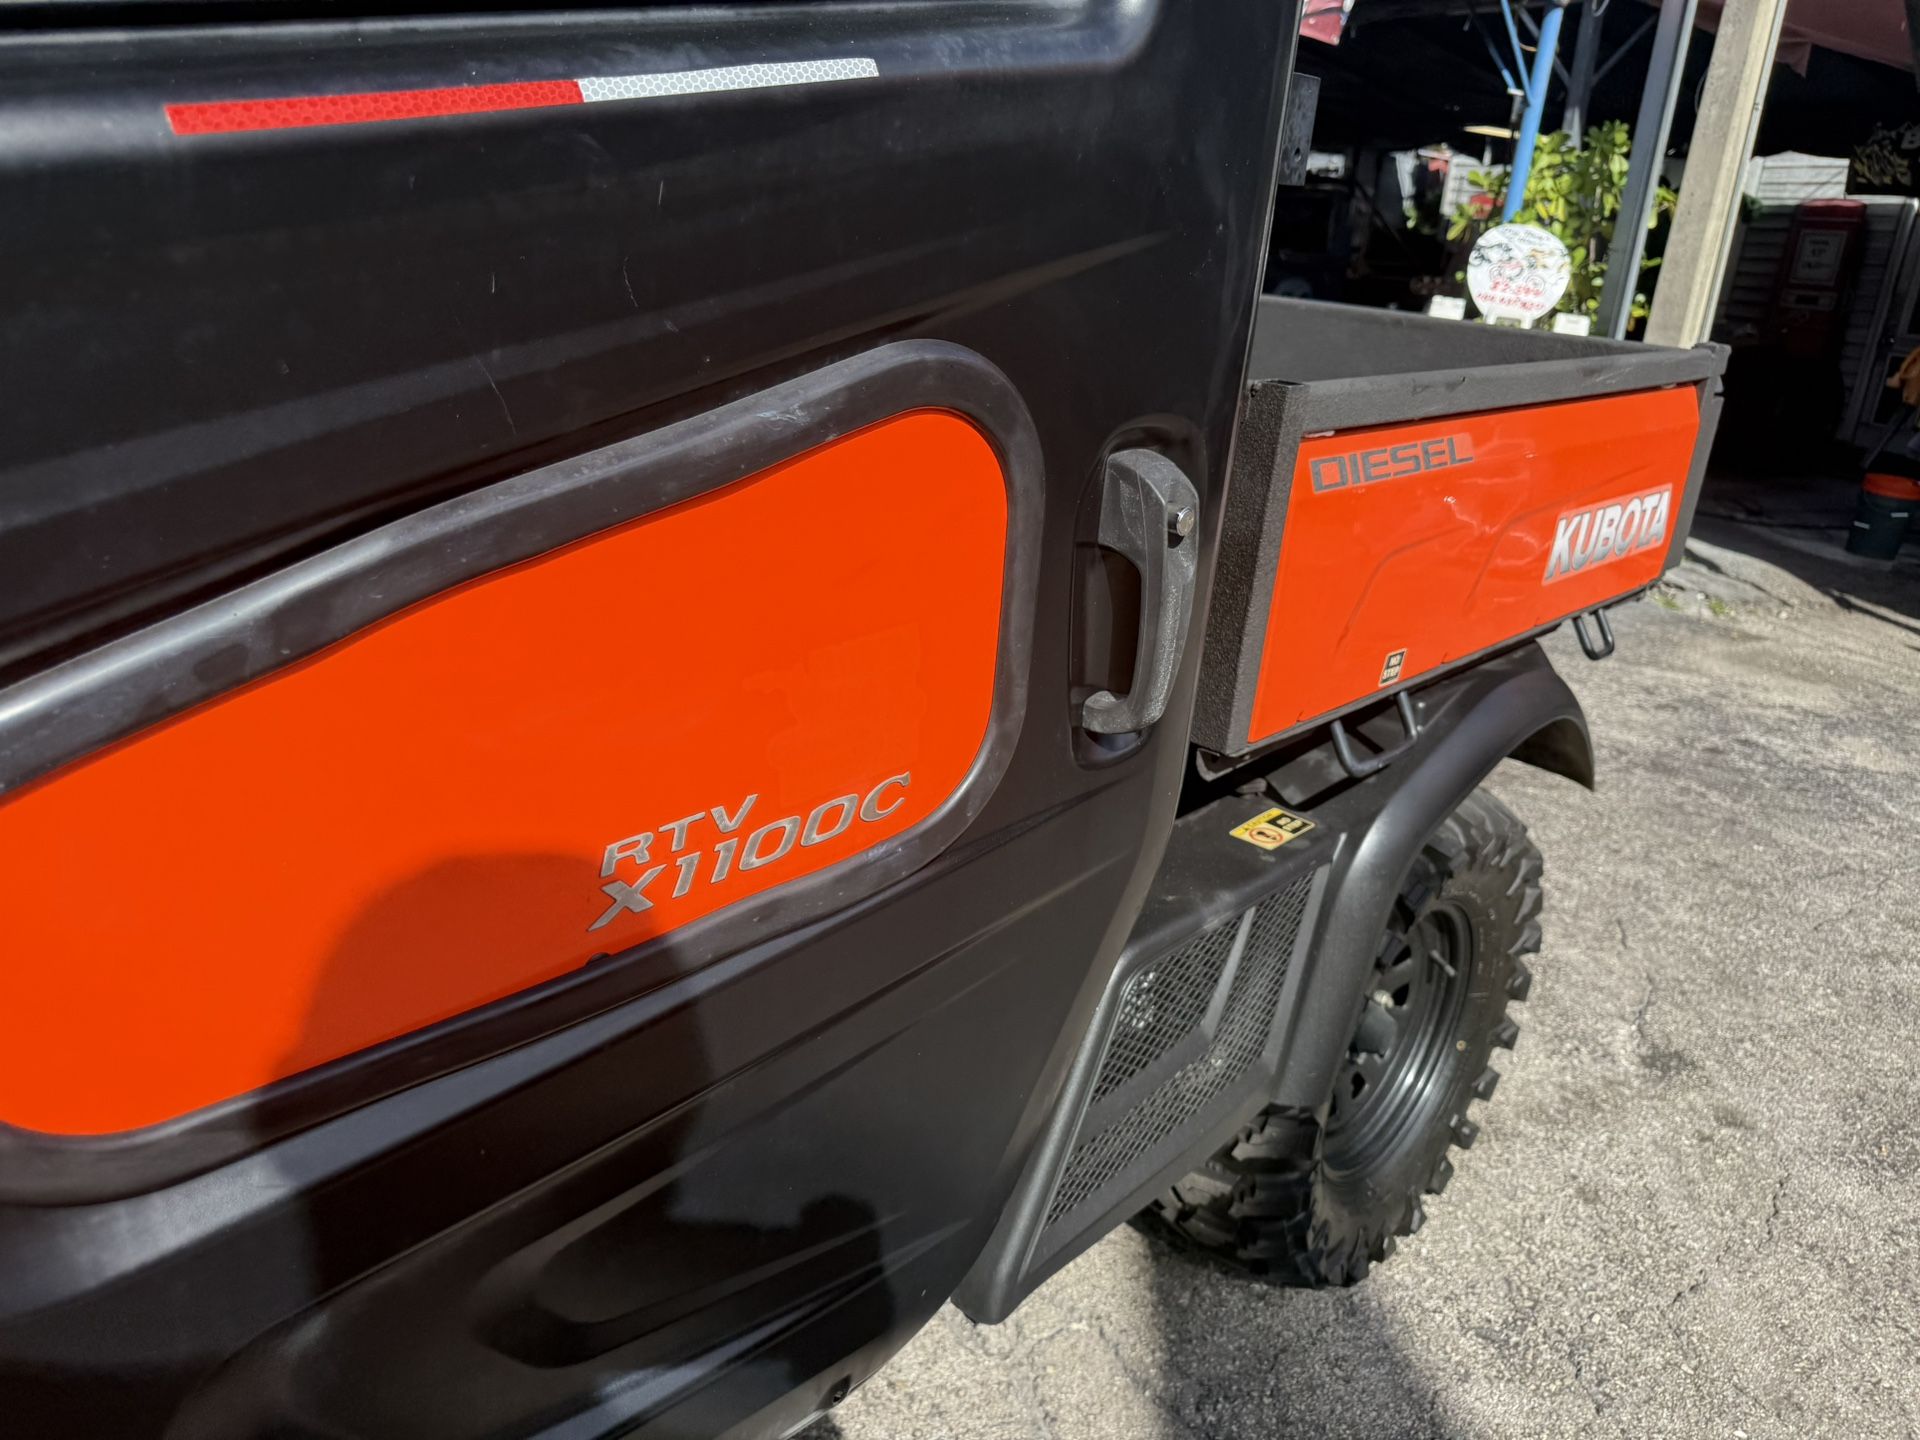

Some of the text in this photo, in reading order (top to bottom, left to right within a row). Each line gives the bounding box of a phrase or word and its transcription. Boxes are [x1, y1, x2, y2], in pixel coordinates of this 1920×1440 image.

[1310, 436, 1474, 491] DIESEL
[1544, 488, 1673, 580] KUBOTA
[586, 771, 911, 932] X1100C
[599, 793, 758, 878] RTV
